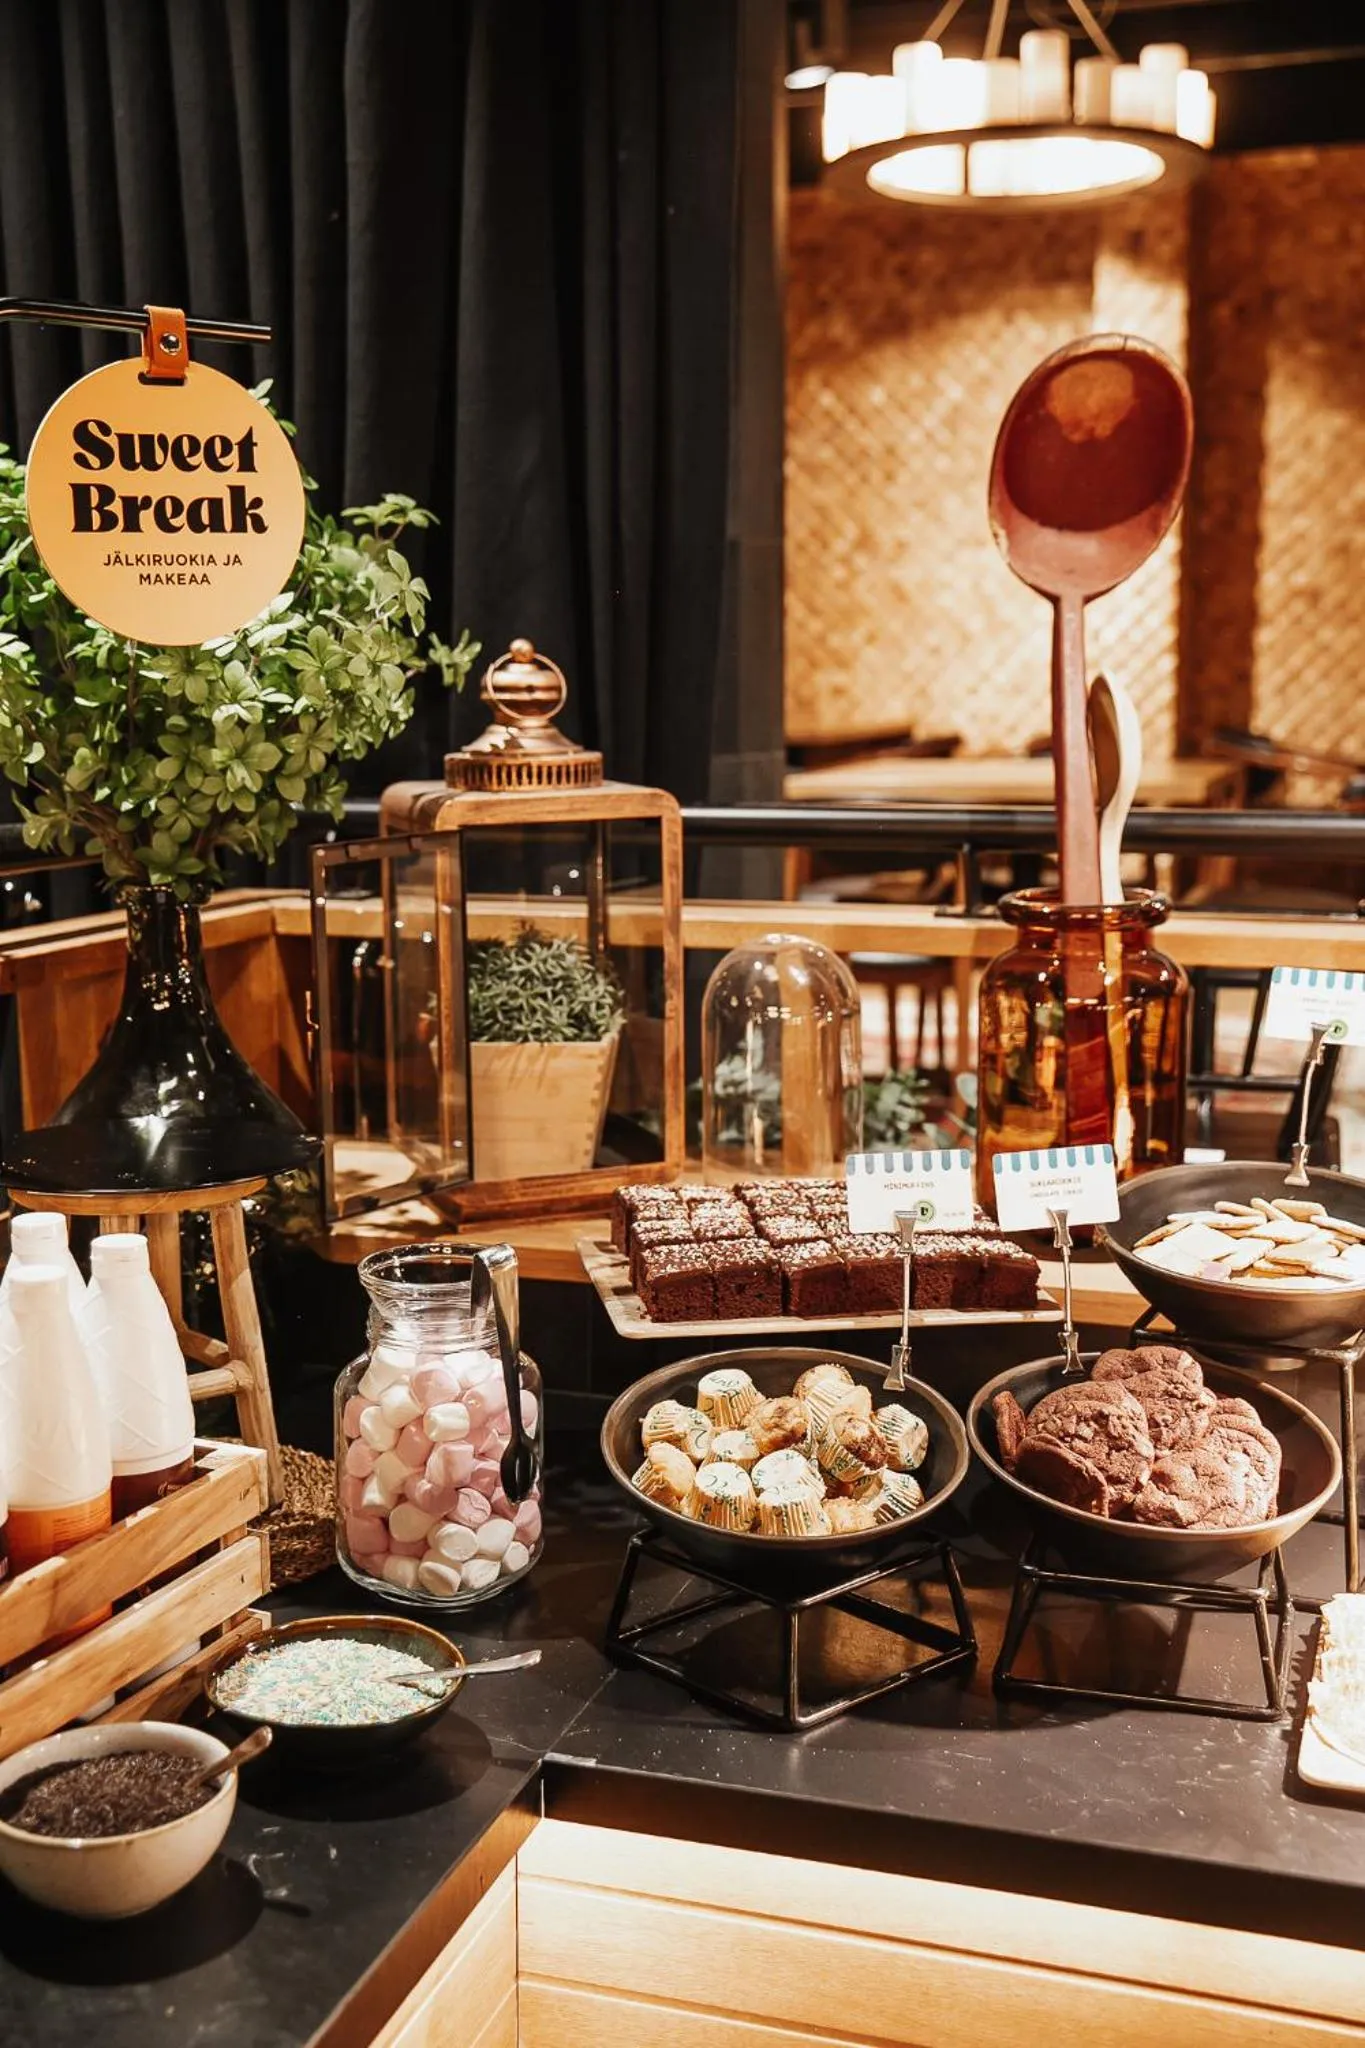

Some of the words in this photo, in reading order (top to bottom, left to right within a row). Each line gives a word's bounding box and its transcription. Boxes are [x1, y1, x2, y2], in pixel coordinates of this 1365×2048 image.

[72, 419, 259, 473] Sweet
[68, 483, 269, 535] Break
[103, 551, 217, 567] JÄLKIRUOKIA
[222, 554, 243, 567] JA
[139, 573, 211, 586] MAKEAA
